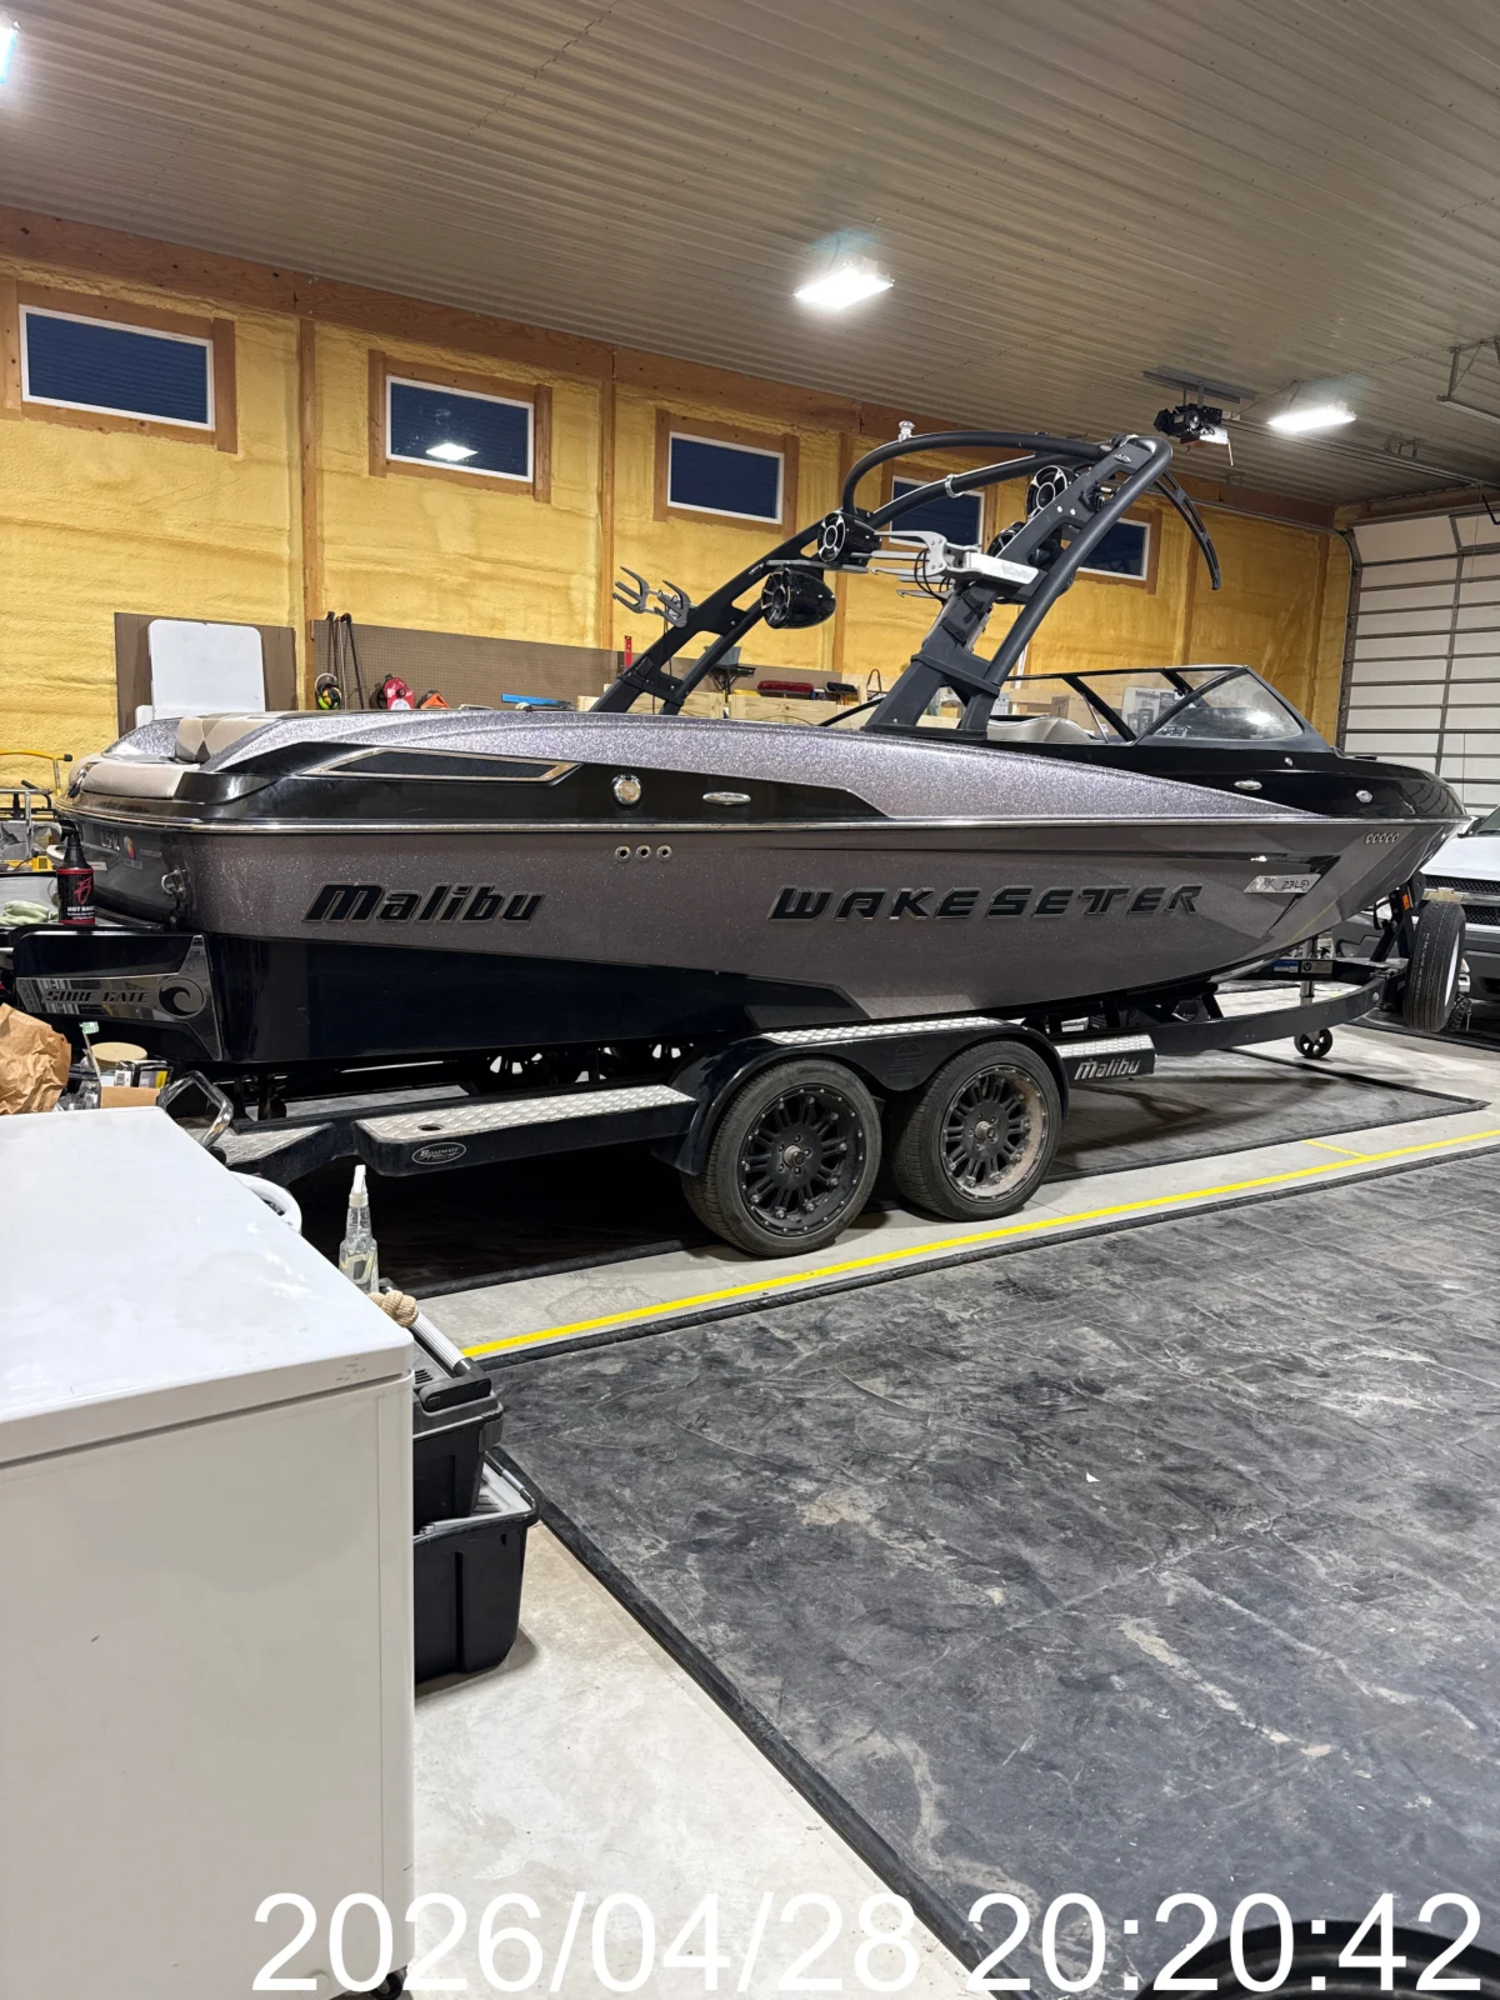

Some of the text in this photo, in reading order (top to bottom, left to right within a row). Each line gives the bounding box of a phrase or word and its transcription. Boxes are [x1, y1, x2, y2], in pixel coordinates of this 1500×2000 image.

[301, 881, 546, 923] Malibu
[767, 884, 1203, 921] WAKESETTER
[45, 990, 151, 1003] SURF GATE
[1074, 1059, 1140, 1080] Malibu
